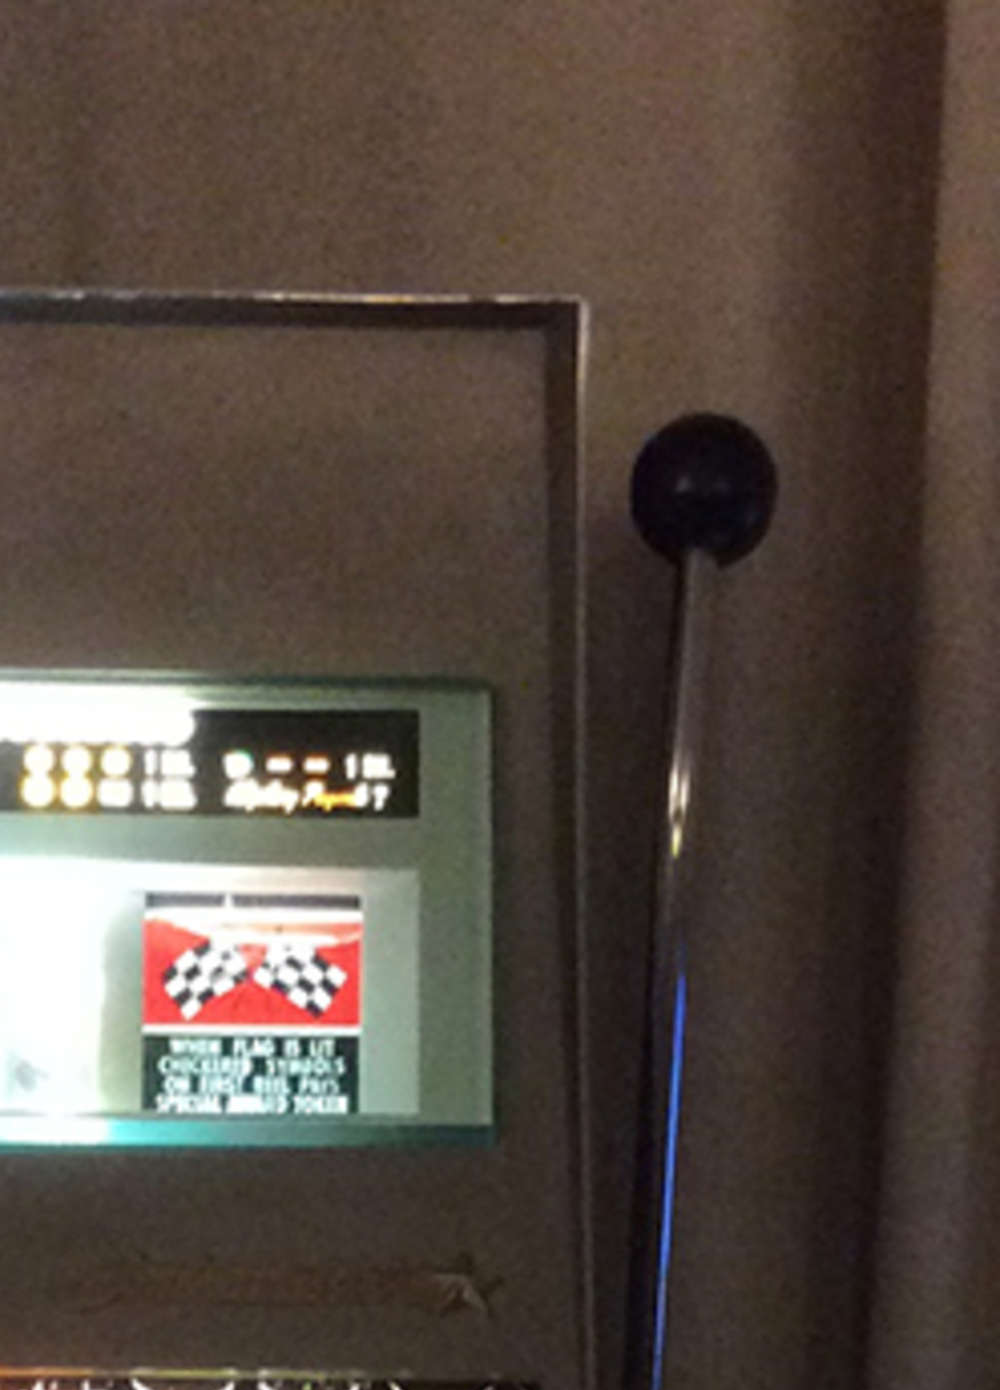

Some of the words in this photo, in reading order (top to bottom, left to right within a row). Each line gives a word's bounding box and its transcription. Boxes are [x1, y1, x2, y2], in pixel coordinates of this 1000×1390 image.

[233, 1039, 275, 1056] FLAG
[284, 1040, 299, 1056] IS
[310, 1040, 335, 1056] LIT
[265, 1056, 346, 1074] SYMBOLS
[164, 1076, 190, 1093] ON
